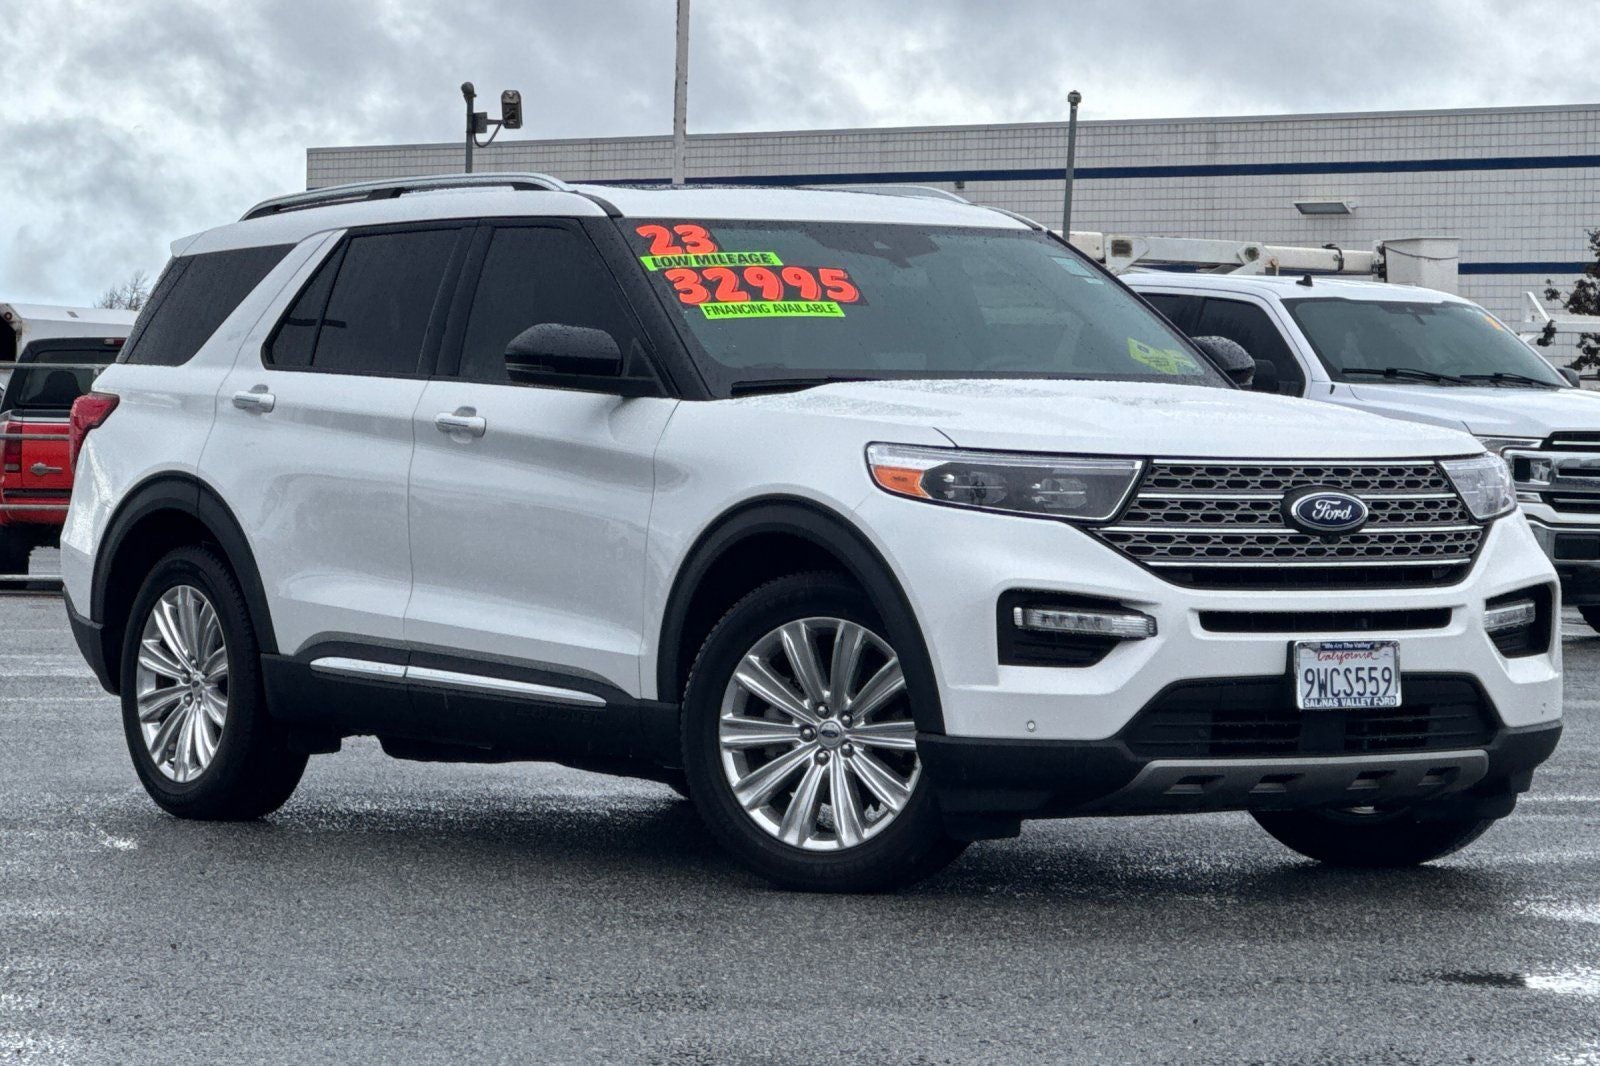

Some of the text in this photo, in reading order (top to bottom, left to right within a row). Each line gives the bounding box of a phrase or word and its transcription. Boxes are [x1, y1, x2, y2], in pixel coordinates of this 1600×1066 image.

[635, 224, 719, 255] 23
[651, 252, 773, 268] LOW MILEAGE
[664, 266, 859, 306] 32995
[704, 301, 838, 316] FINANCING AVAILABLE
[1311, 499, 1353, 521] Ford
[1317, 651, 1379, 665] California
[1304, 666, 1392, 697] 9WCS559
[1340, 697, 1371, 707] VALLEY
[1373, 696, 1396, 706] FORD
